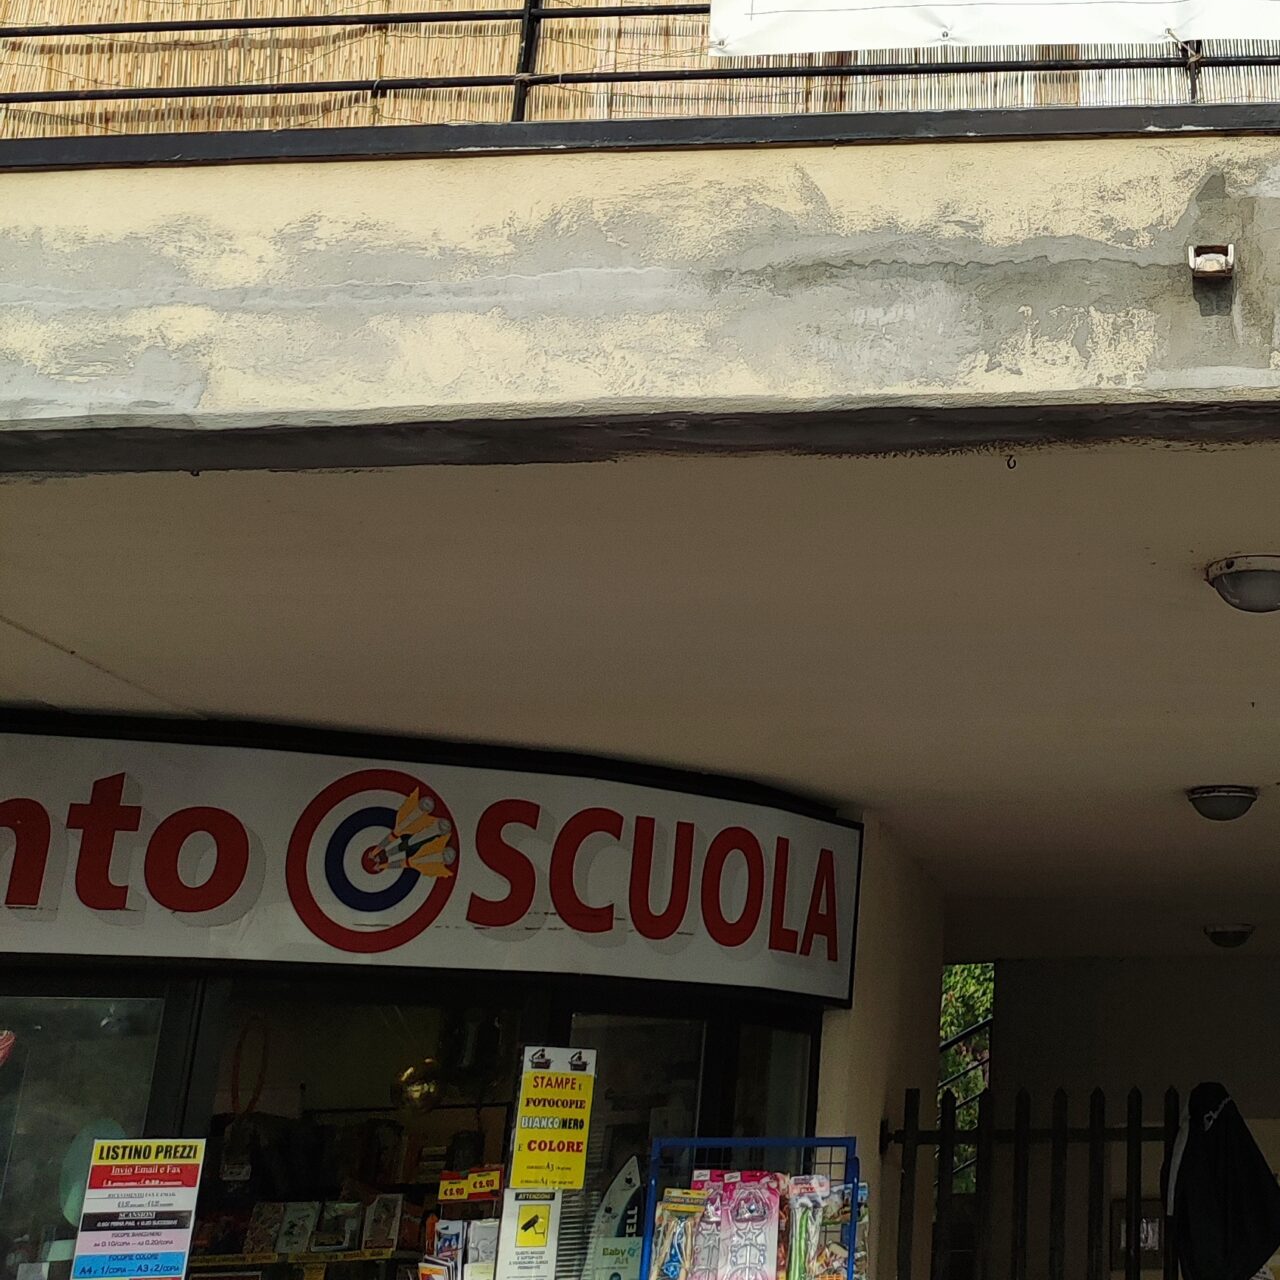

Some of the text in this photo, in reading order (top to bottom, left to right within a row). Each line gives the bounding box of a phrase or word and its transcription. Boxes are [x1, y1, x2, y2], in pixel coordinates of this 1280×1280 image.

[465, 798, 840, 962] SCUOLA
[532, 1075, 577, 1090] STAMPE
[525, 1097, 586, 1110] FOTOCOPIE
[521, 1116, 585, 1131] BIANCO NERO
[98, 1144, 199, 1160] LISTINO PREZZI
[527, 1140, 584, 1153] COLORE
[111, 1165, 133, 1175] Invio
[134, 1164, 158, 1174] Email
[166, 1165, 181, 1174] Fax
[602, 1247, 626, 1257] Baby
